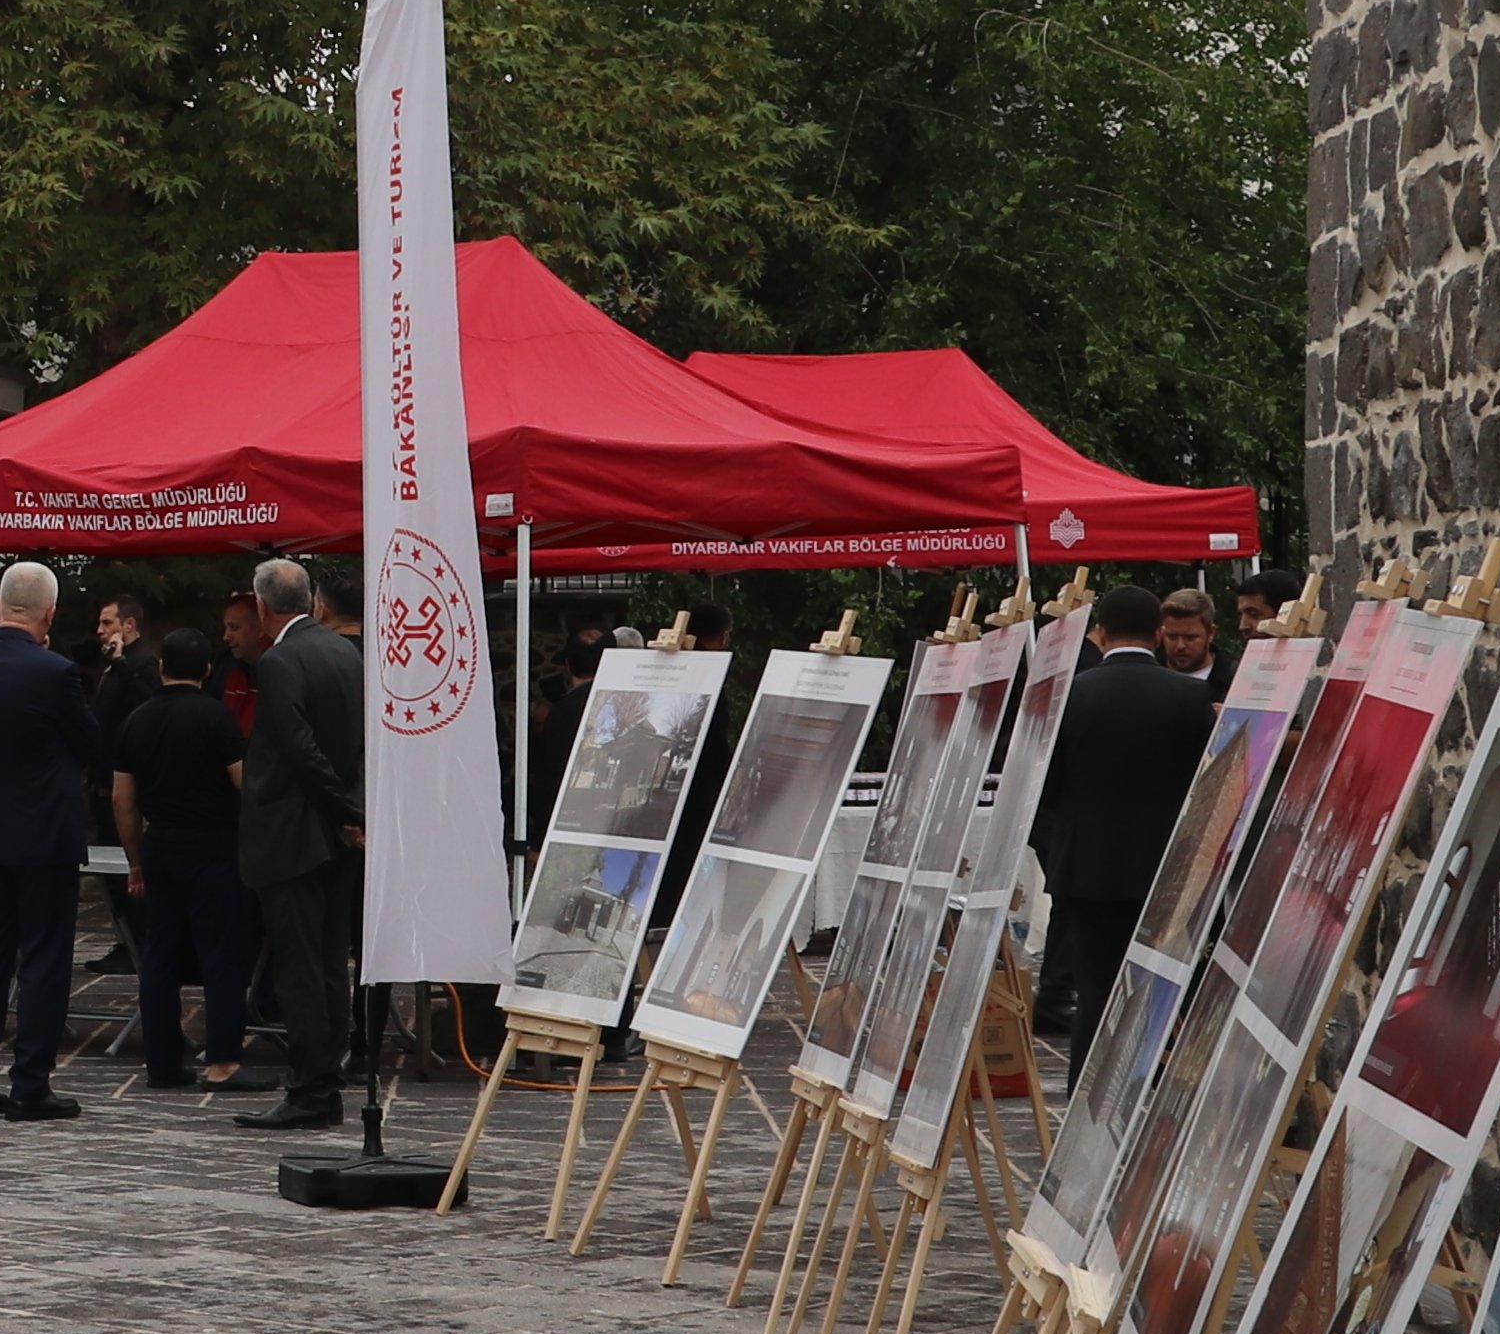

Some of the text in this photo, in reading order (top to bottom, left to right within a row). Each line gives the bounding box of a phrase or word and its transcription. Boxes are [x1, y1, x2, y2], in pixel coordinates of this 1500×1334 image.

[392, 235, 403, 281] VE
[14, 481, 246, 510] T.C. VAKIFLAR GENEL MÜDÜRLÜĞÜ
[67, 514, 132, 531] VAKIFLAR
[135, 511, 183, 531] BÖLGE
[187, 502, 278, 528] MÜDÜRLÜĞÜ
[769, 540, 845, 554] VAKIFLAR
[849, 537, 903, 553] BÖLGE
[907, 533, 1006, 551] MÜDÜRLÜĞÜ
